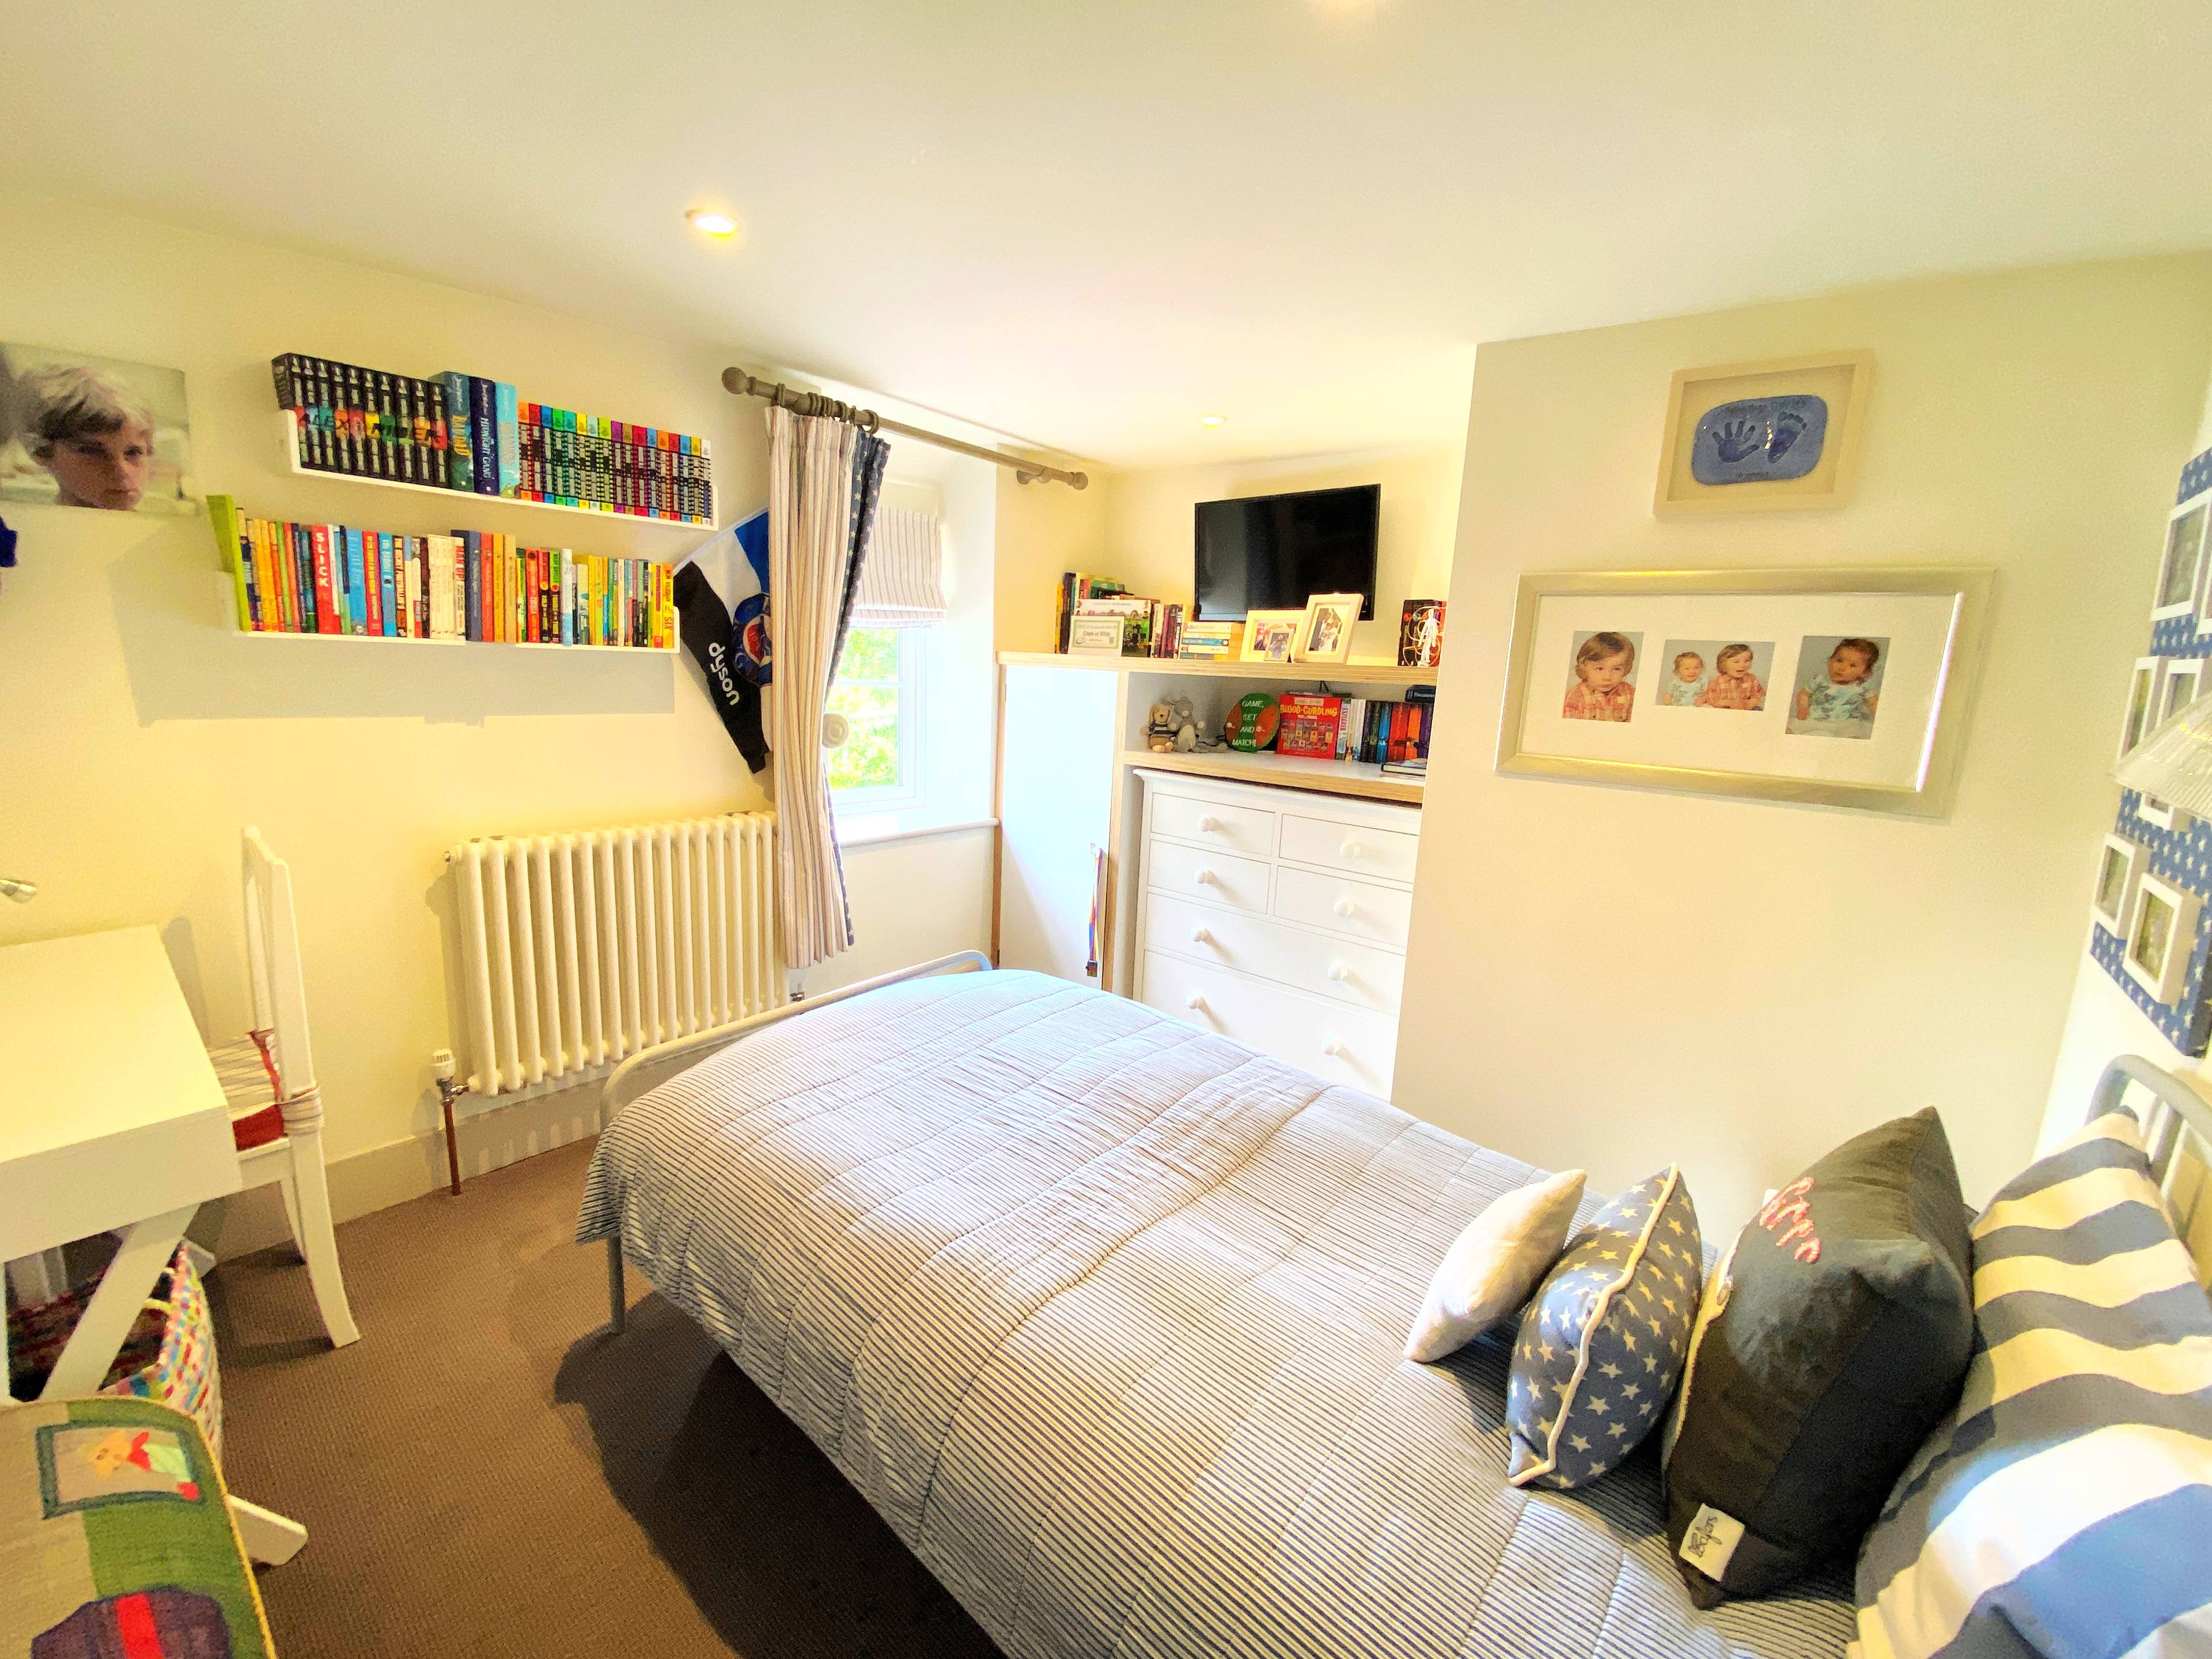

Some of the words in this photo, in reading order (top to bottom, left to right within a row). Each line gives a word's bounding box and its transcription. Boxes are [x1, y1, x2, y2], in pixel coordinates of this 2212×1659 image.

[479, 417, 491, 455] MIDNIGHT
[480, 456, 490, 479] GANG
[316, 532, 329, 588] SLICK
[664, 616, 672, 630] SIX
[708, 642, 740, 706] dyson
[1242, 700, 1264, 709] GAME,
[1280, 704, 1338, 717] BLOOD-CURDLING
[1232, 738, 1256, 747] MATCH!
